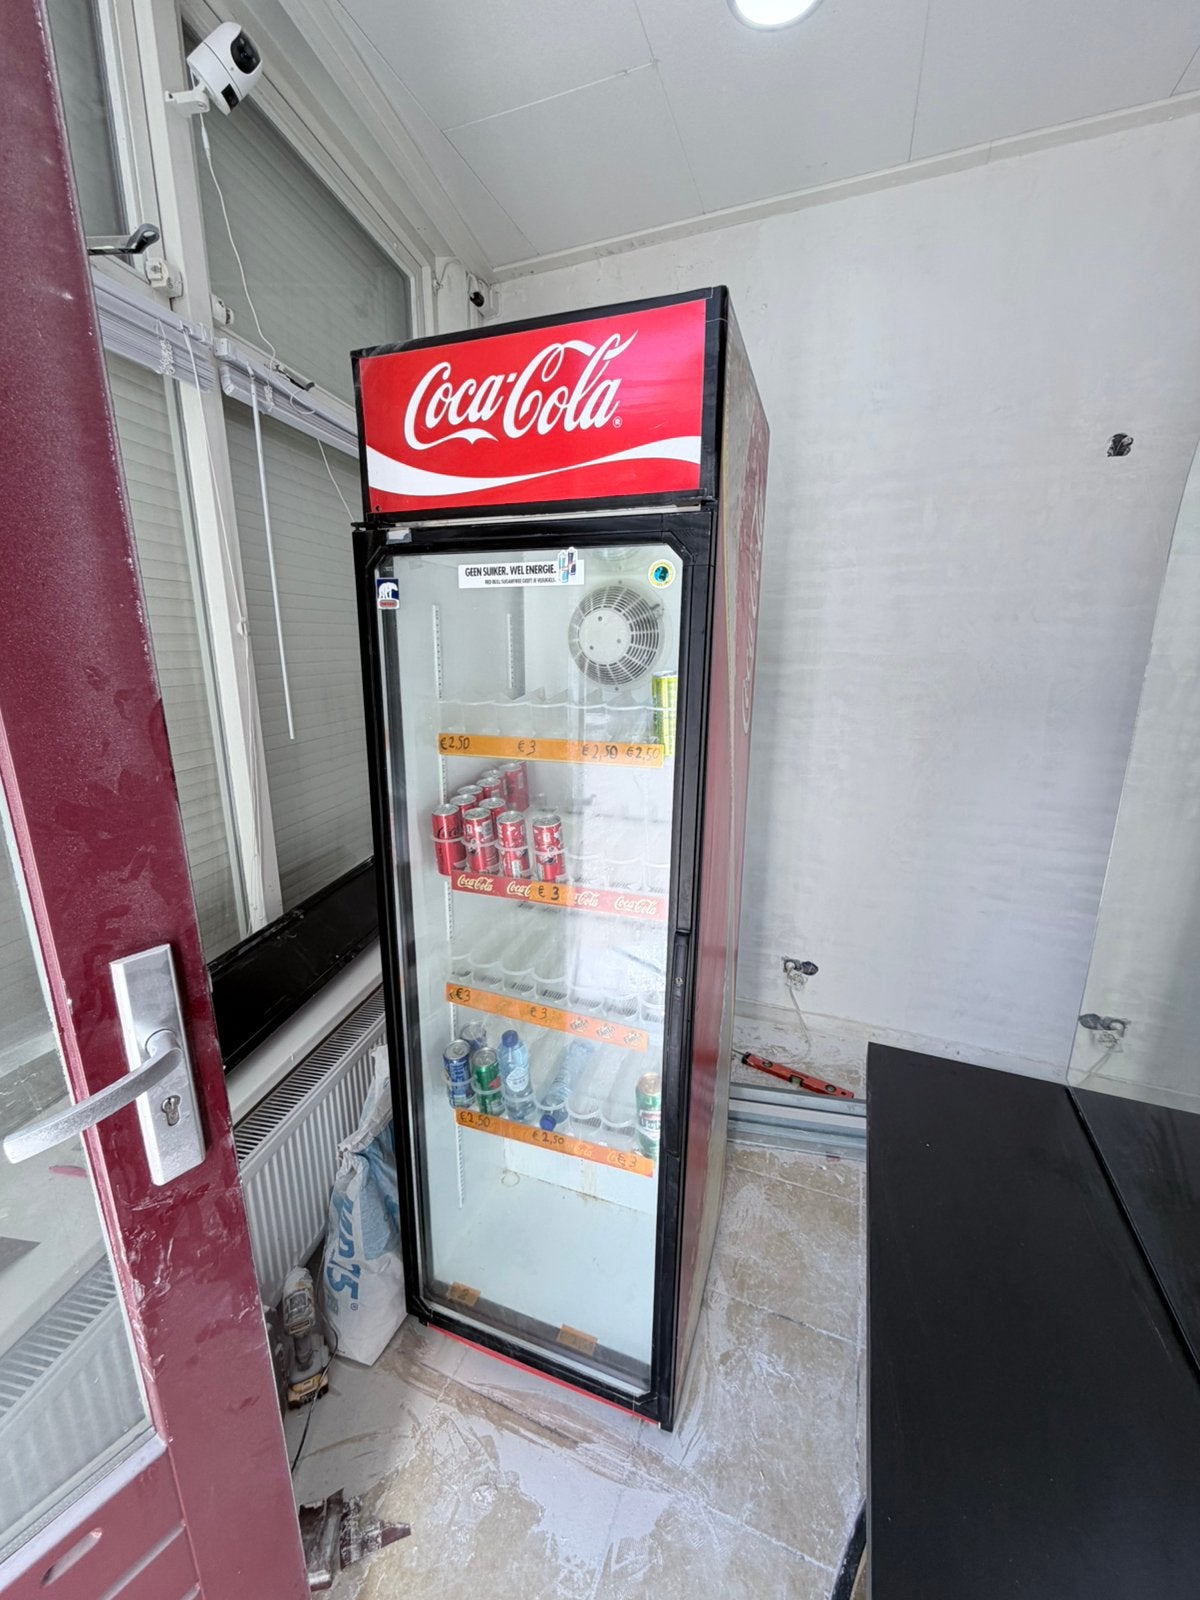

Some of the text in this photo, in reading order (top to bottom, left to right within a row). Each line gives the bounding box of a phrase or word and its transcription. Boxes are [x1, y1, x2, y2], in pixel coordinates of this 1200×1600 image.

[404, 329, 639, 451] Coca-Cola
[465, 564, 556, 577] GEEN SUIKER. WEL ENERGIE.
